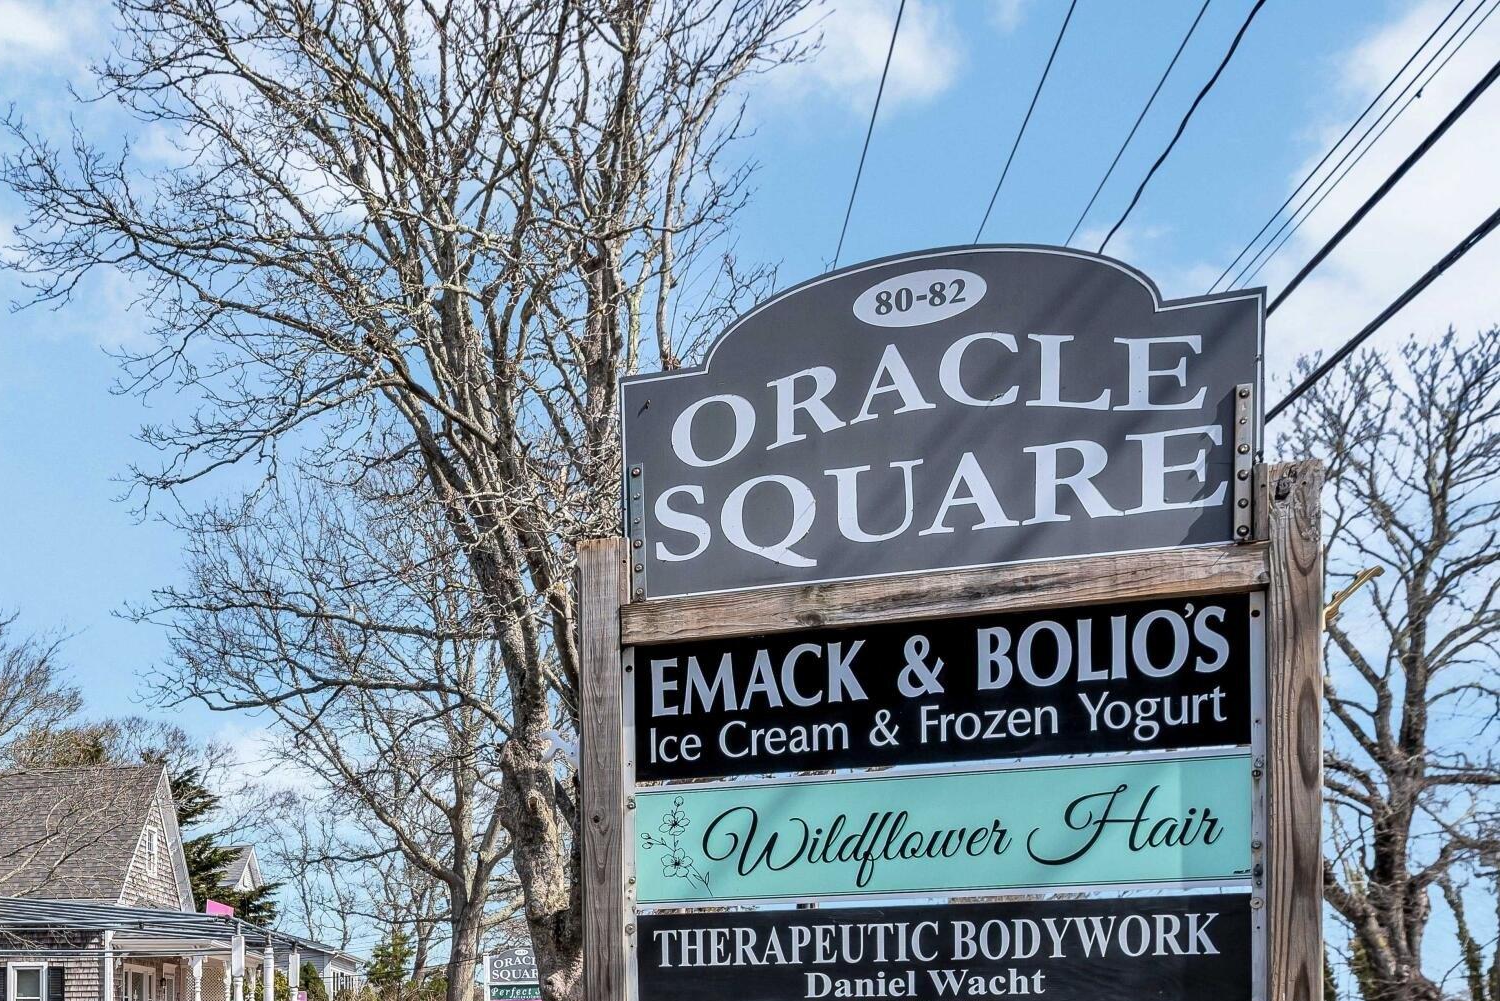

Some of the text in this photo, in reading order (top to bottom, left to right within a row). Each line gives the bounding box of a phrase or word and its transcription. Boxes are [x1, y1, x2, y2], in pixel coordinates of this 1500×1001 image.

[874, 278, 967, 316] 80-82
[671, 331, 1208, 468] ORACLE
[655, 425, 1230, 568] SQUARE
[650, 602, 1231, 719] EMACK & BOLIO'S
[650, 687, 1228, 764] Ice Cream & Frozen Yogurt
[702, 784, 1226, 888] Wildflower Hair
[652, 912, 1221, 970] THERAPEUTIC BODYWORK
[491, 987, 531, 998] Perfect
[804, 966, 1047, 1000] Daniel Wacht
